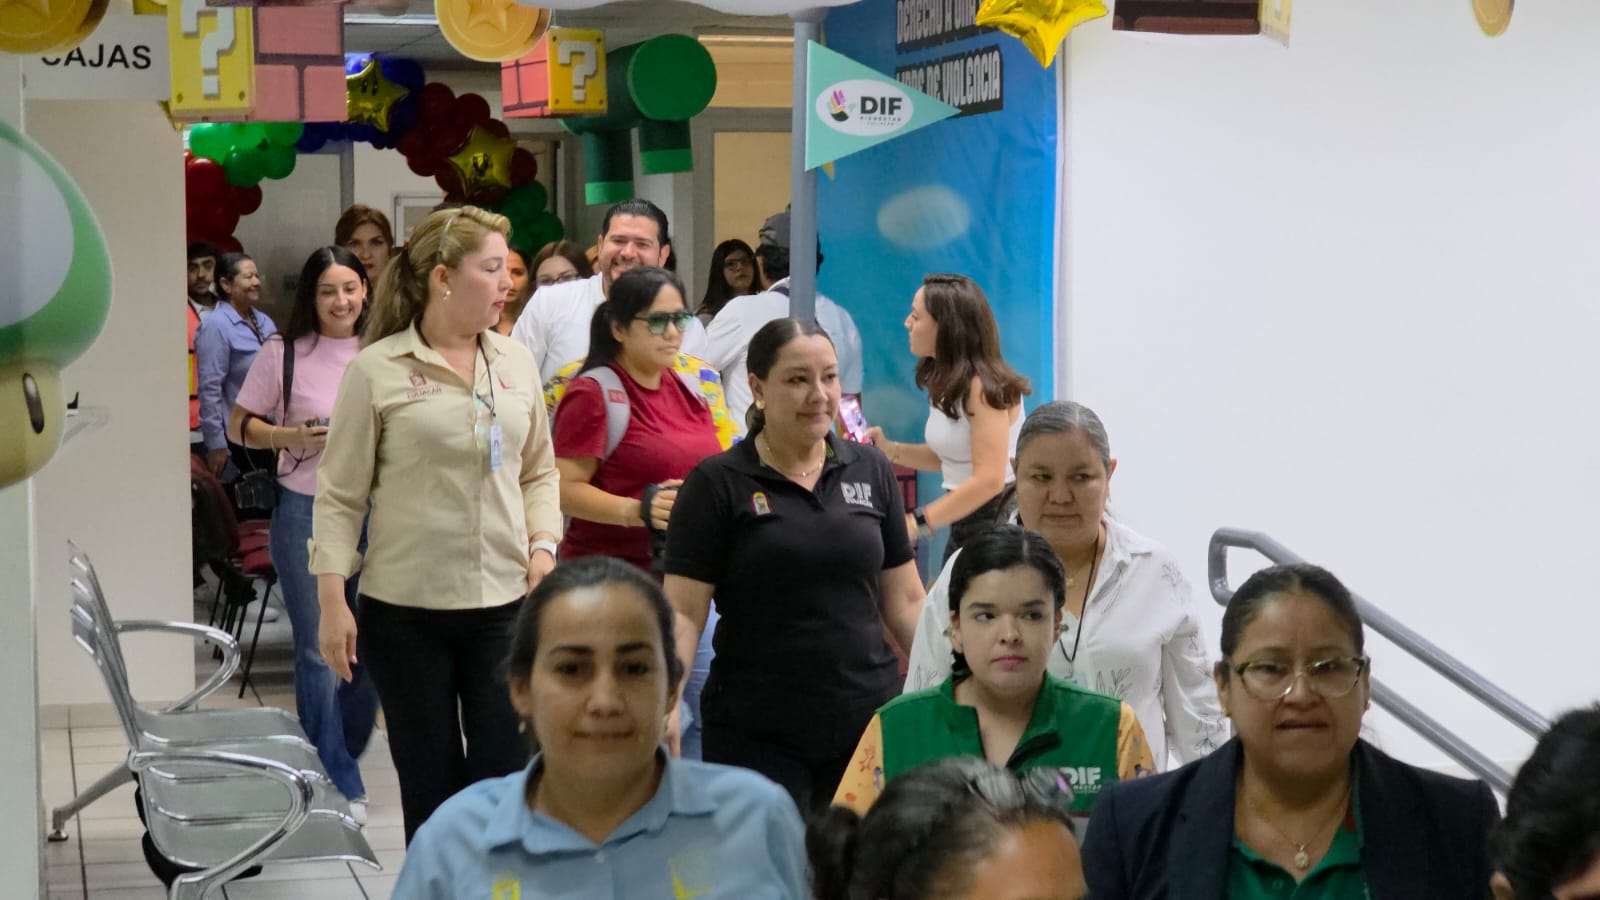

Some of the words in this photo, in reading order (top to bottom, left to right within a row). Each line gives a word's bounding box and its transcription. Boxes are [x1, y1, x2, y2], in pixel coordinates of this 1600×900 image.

[896, 0, 942, 45] DERECHO
[942, 50, 1000, 108] VIOLENCIA
[860, 96, 903, 116] DIF
[840, 482, 872, 501] DIF
